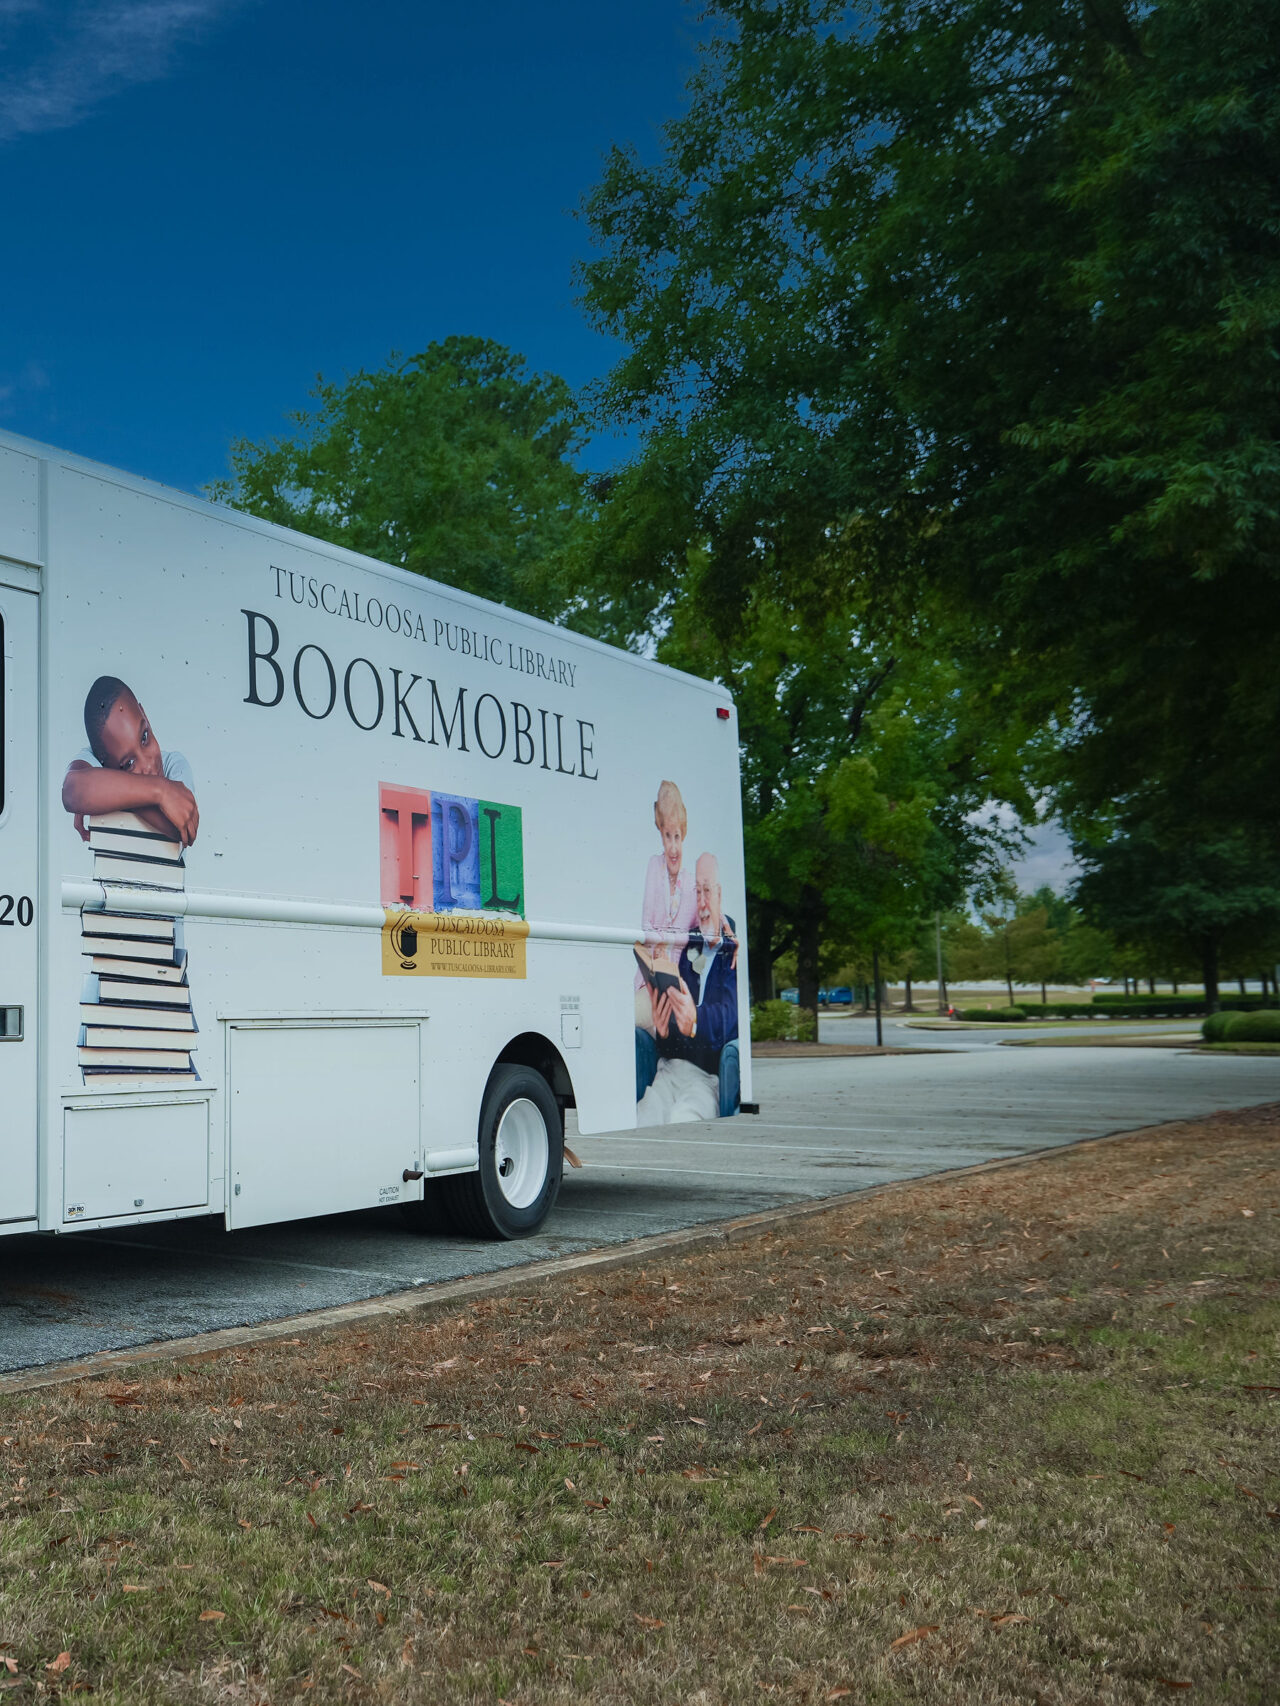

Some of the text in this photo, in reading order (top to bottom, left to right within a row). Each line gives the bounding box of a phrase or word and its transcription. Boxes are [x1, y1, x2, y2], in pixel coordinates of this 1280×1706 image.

[270, 565, 577, 688] TUSCALOOSA PUBLIC LIBRARY
[240, 608, 599, 781] BOOKMOBILE
[381, 788, 521, 909] TPL
[431, 938, 515, 958] PUBLIC LIBRARY
[434, 916, 505, 936] TUSCALOOSA
[379, 1186, 400, 1195] CAUTION
